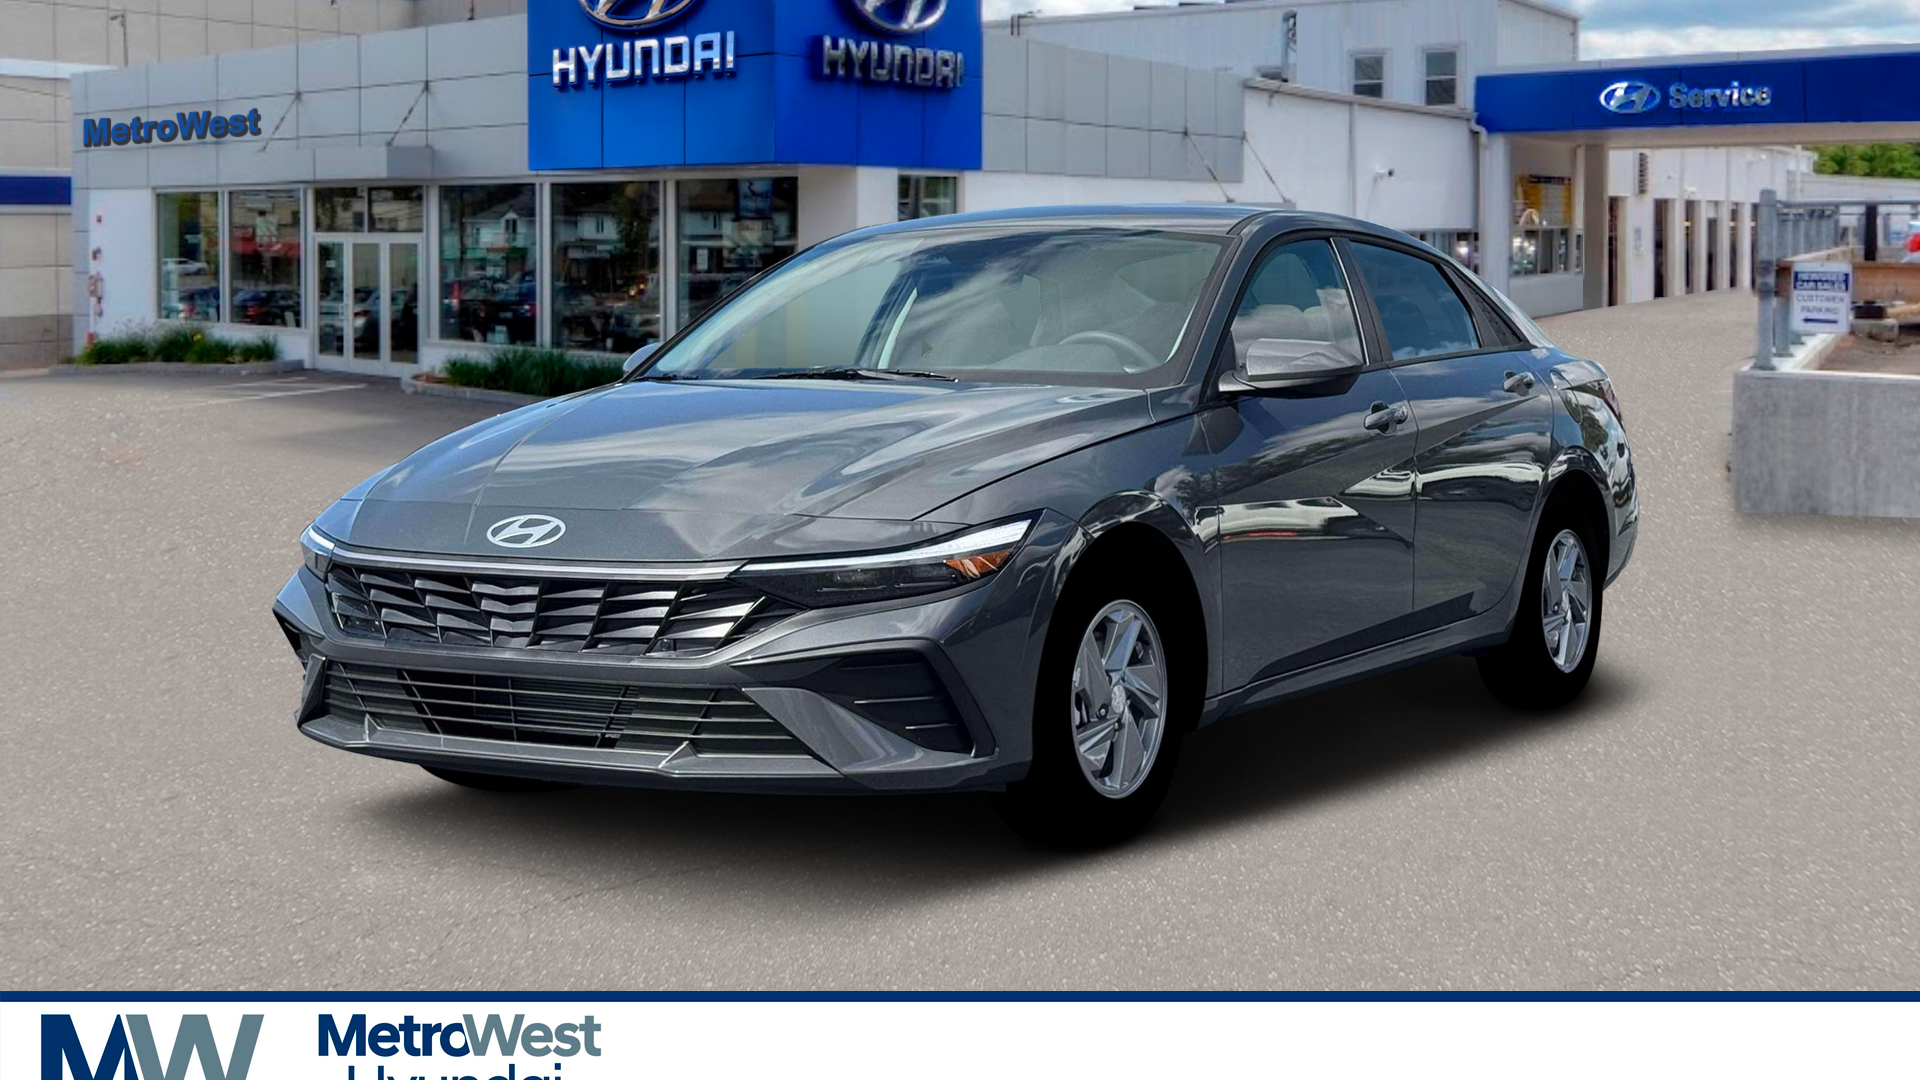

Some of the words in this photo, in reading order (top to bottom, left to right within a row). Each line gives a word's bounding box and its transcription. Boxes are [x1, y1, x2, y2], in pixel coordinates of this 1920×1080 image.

[553, 31, 735, 85] HYUNDAI
[822, 34, 964, 88] HYUNDAI
[1669, 80, 1772, 109] Service
[83, 108, 261, 147] MetroWest
[1797, 294, 1845, 303] CUSTOMER
[1800, 305, 1840, 315] PARKING
